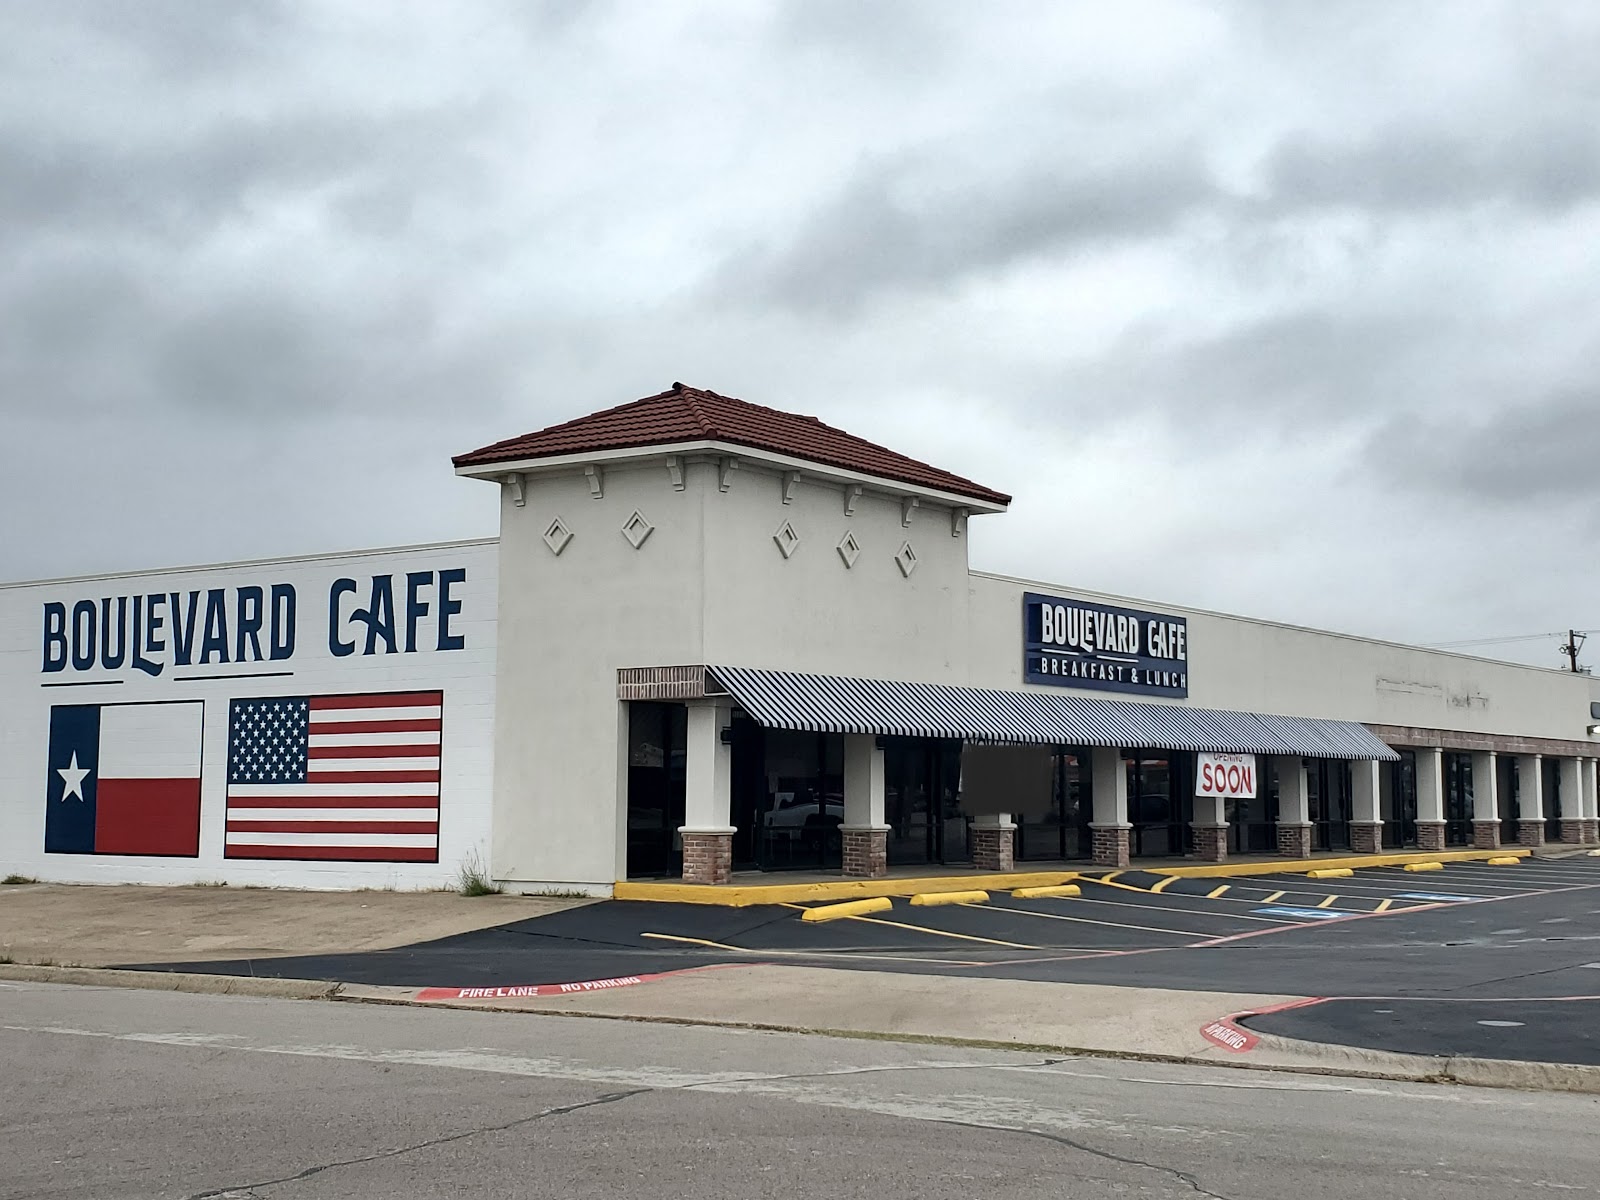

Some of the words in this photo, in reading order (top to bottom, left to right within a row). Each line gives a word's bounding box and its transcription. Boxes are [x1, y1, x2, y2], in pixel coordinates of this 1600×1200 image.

[41, 583, 296, 676] BOULEVARD
[328, 568, 466, 657] CAFE
[1041, 603, 1139, 653] BOULEVARD
[1148, 620, 1186, 661] CAFE
[1041, 657, 1122, 682] BREAKFAST
[1131, 668, 1139, 683] &
[1146, 670, 1186, 688] LUNCH
[1202, 763, 1252, 793] SOON
[458, 988, 494, 998] FIRE
[496, 987, 539, 997] LANE
[560, 982, 581, 993] NO
[585, 976, 641, 990] PARKING
